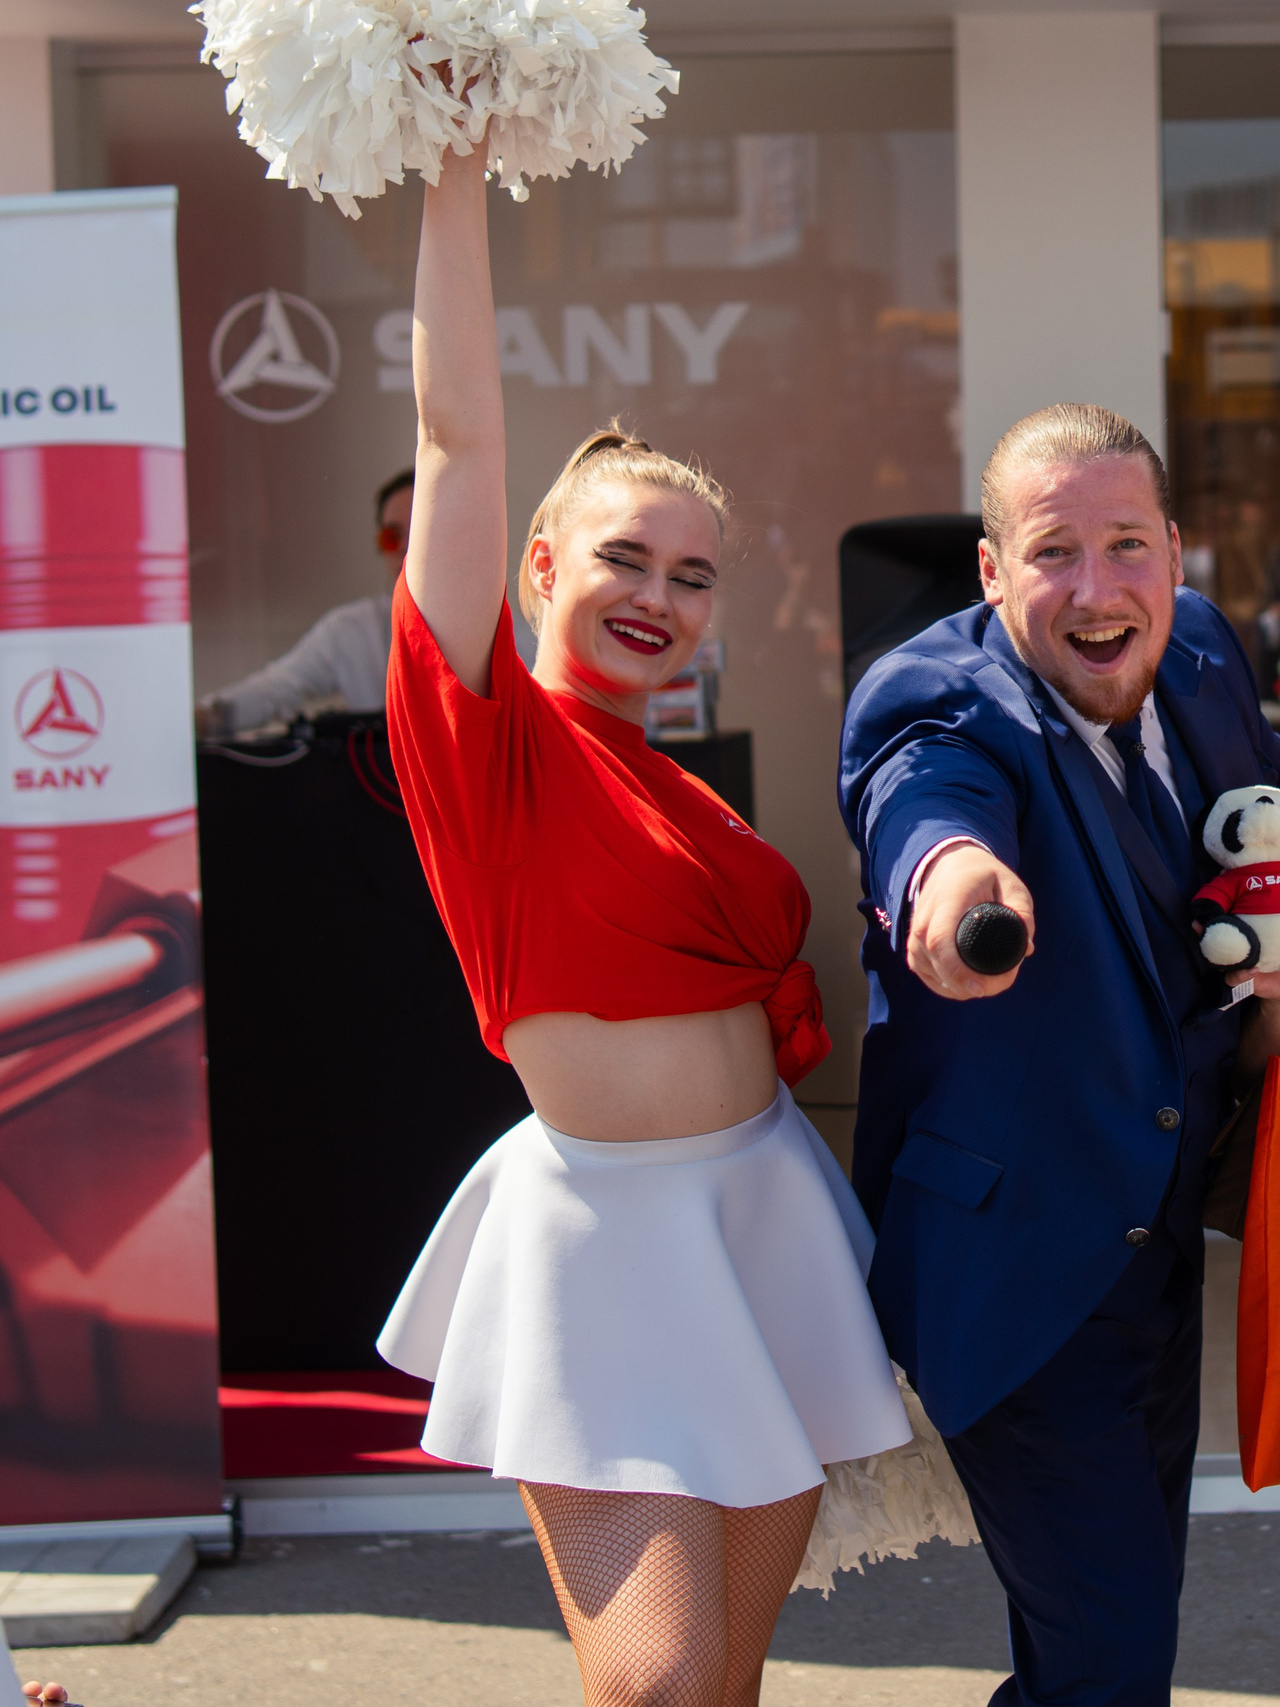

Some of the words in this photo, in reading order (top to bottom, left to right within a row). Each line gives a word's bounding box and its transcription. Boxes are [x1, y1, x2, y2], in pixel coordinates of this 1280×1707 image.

[1, 388, 41, 418] IC
[51, 384, 117, 415] OIL
[13, 763, 112, 792] SANY
